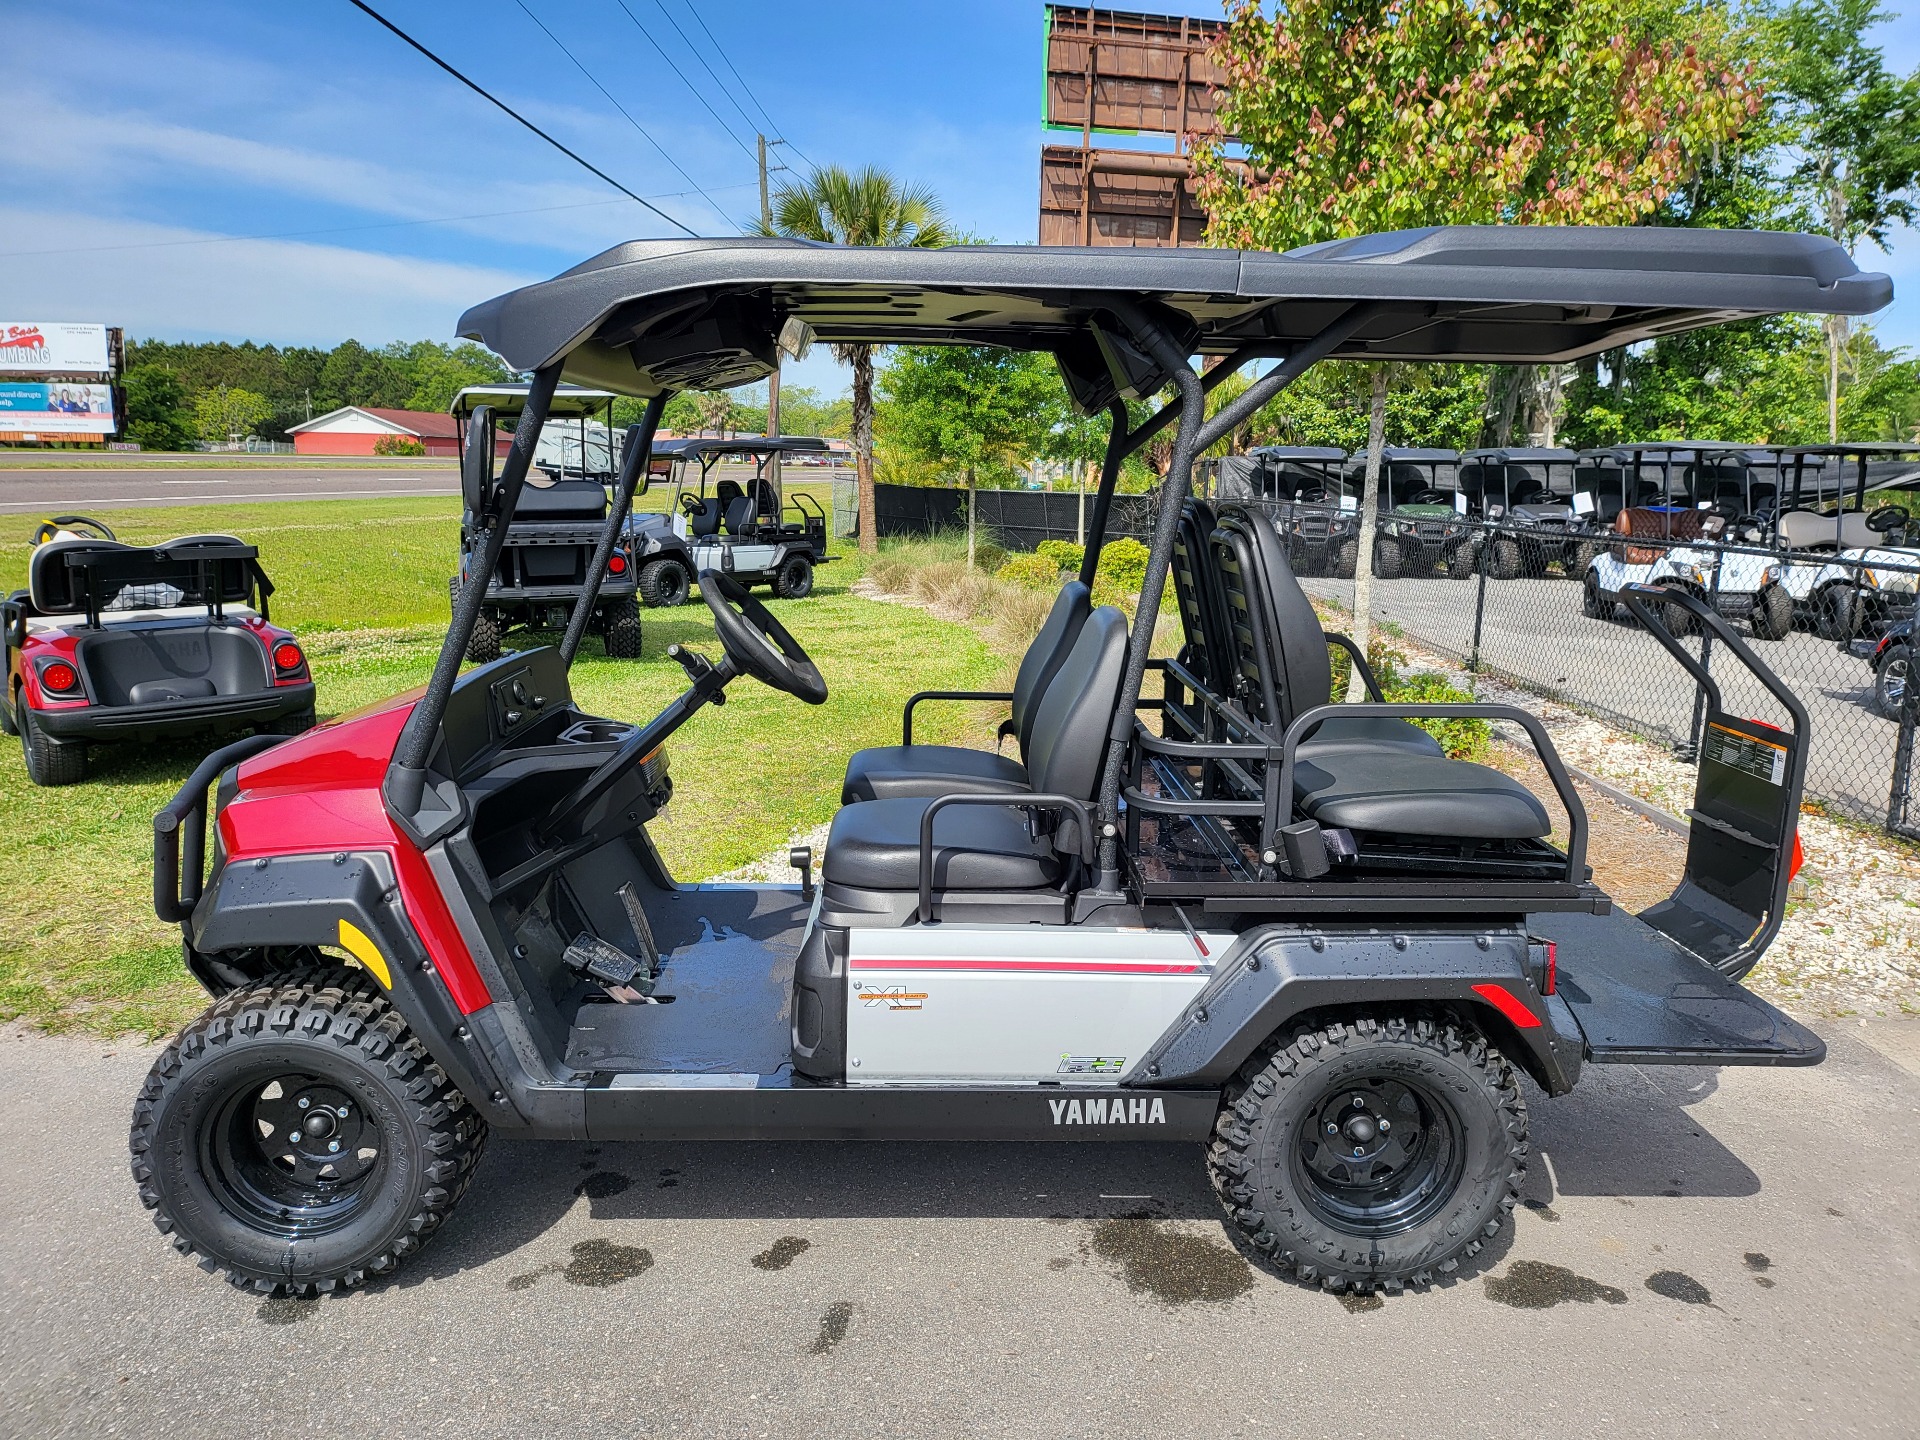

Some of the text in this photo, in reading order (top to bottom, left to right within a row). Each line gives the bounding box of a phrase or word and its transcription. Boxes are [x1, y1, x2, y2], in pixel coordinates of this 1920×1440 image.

[17, 391, 41, 400] disrupts
[129, 640, 202, 657] YAAHA
[1048, 1097, 1166, 1125] YAMAHA
